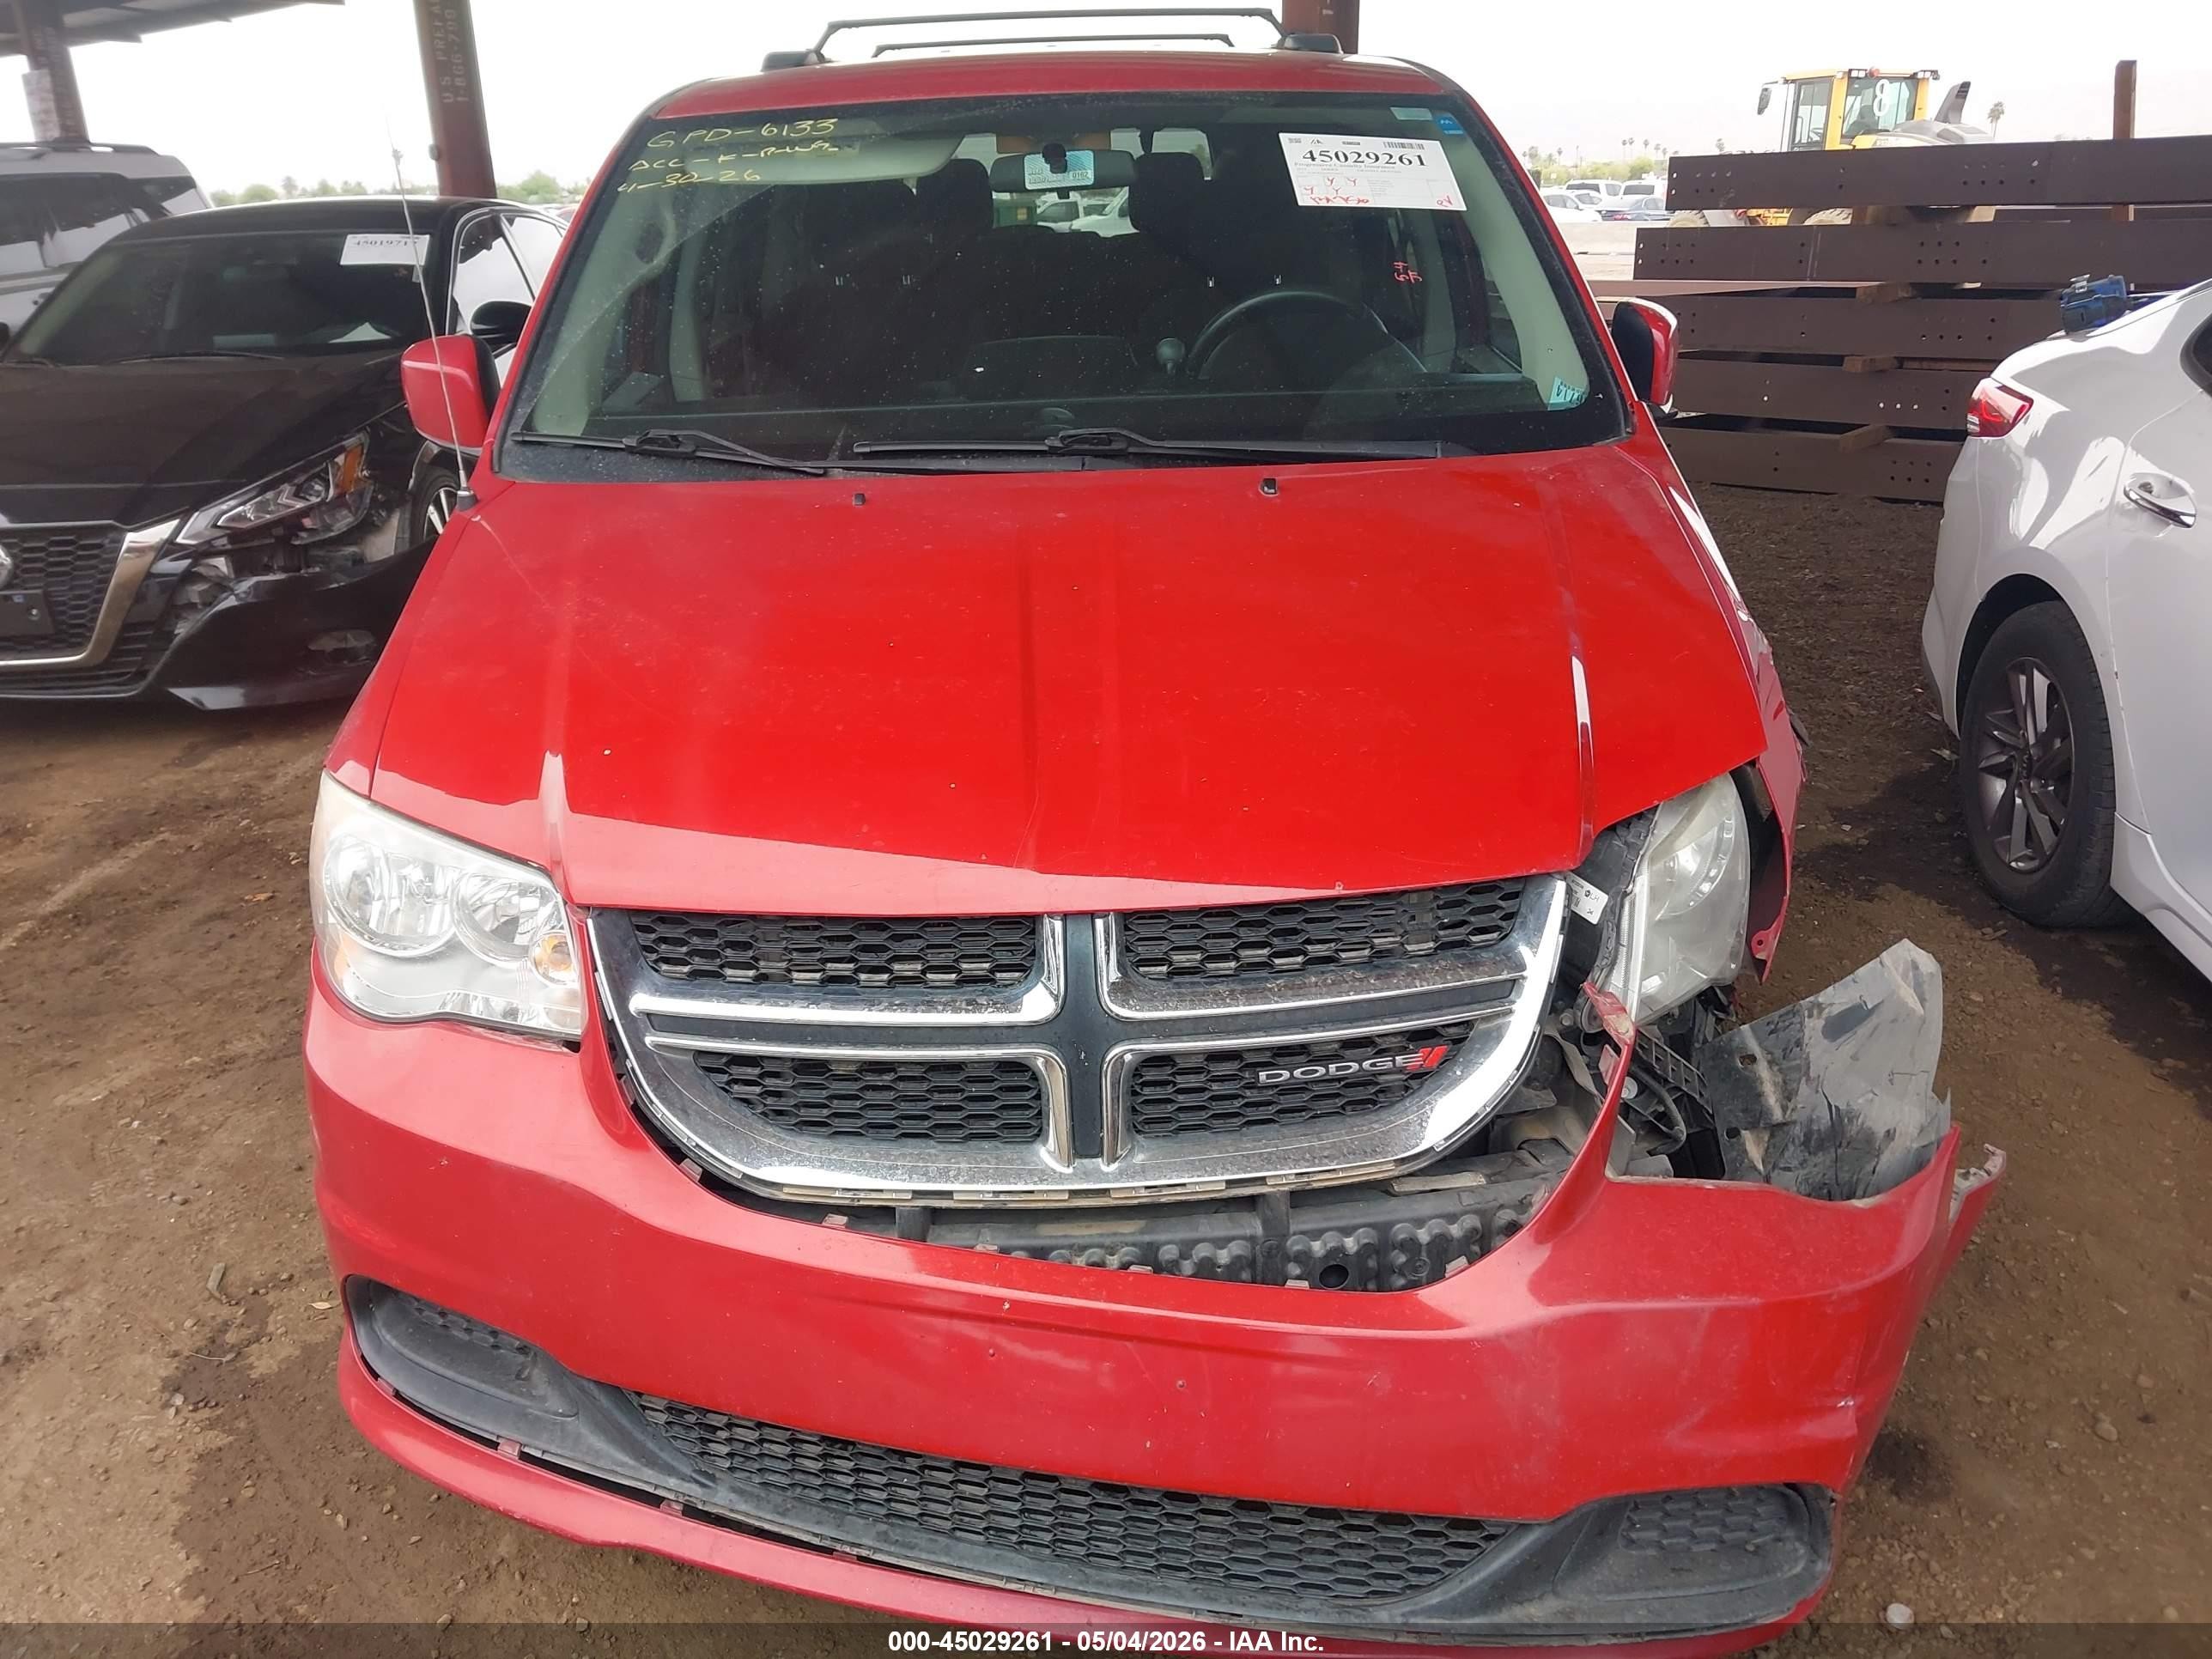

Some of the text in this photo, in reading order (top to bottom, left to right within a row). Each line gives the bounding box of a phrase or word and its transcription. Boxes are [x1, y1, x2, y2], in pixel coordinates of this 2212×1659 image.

[1873, 78, 1889, 117] 8
[1302, 149, 1427, 167] 45029261
[1258, 1053, 1425, 1084] DODGE
